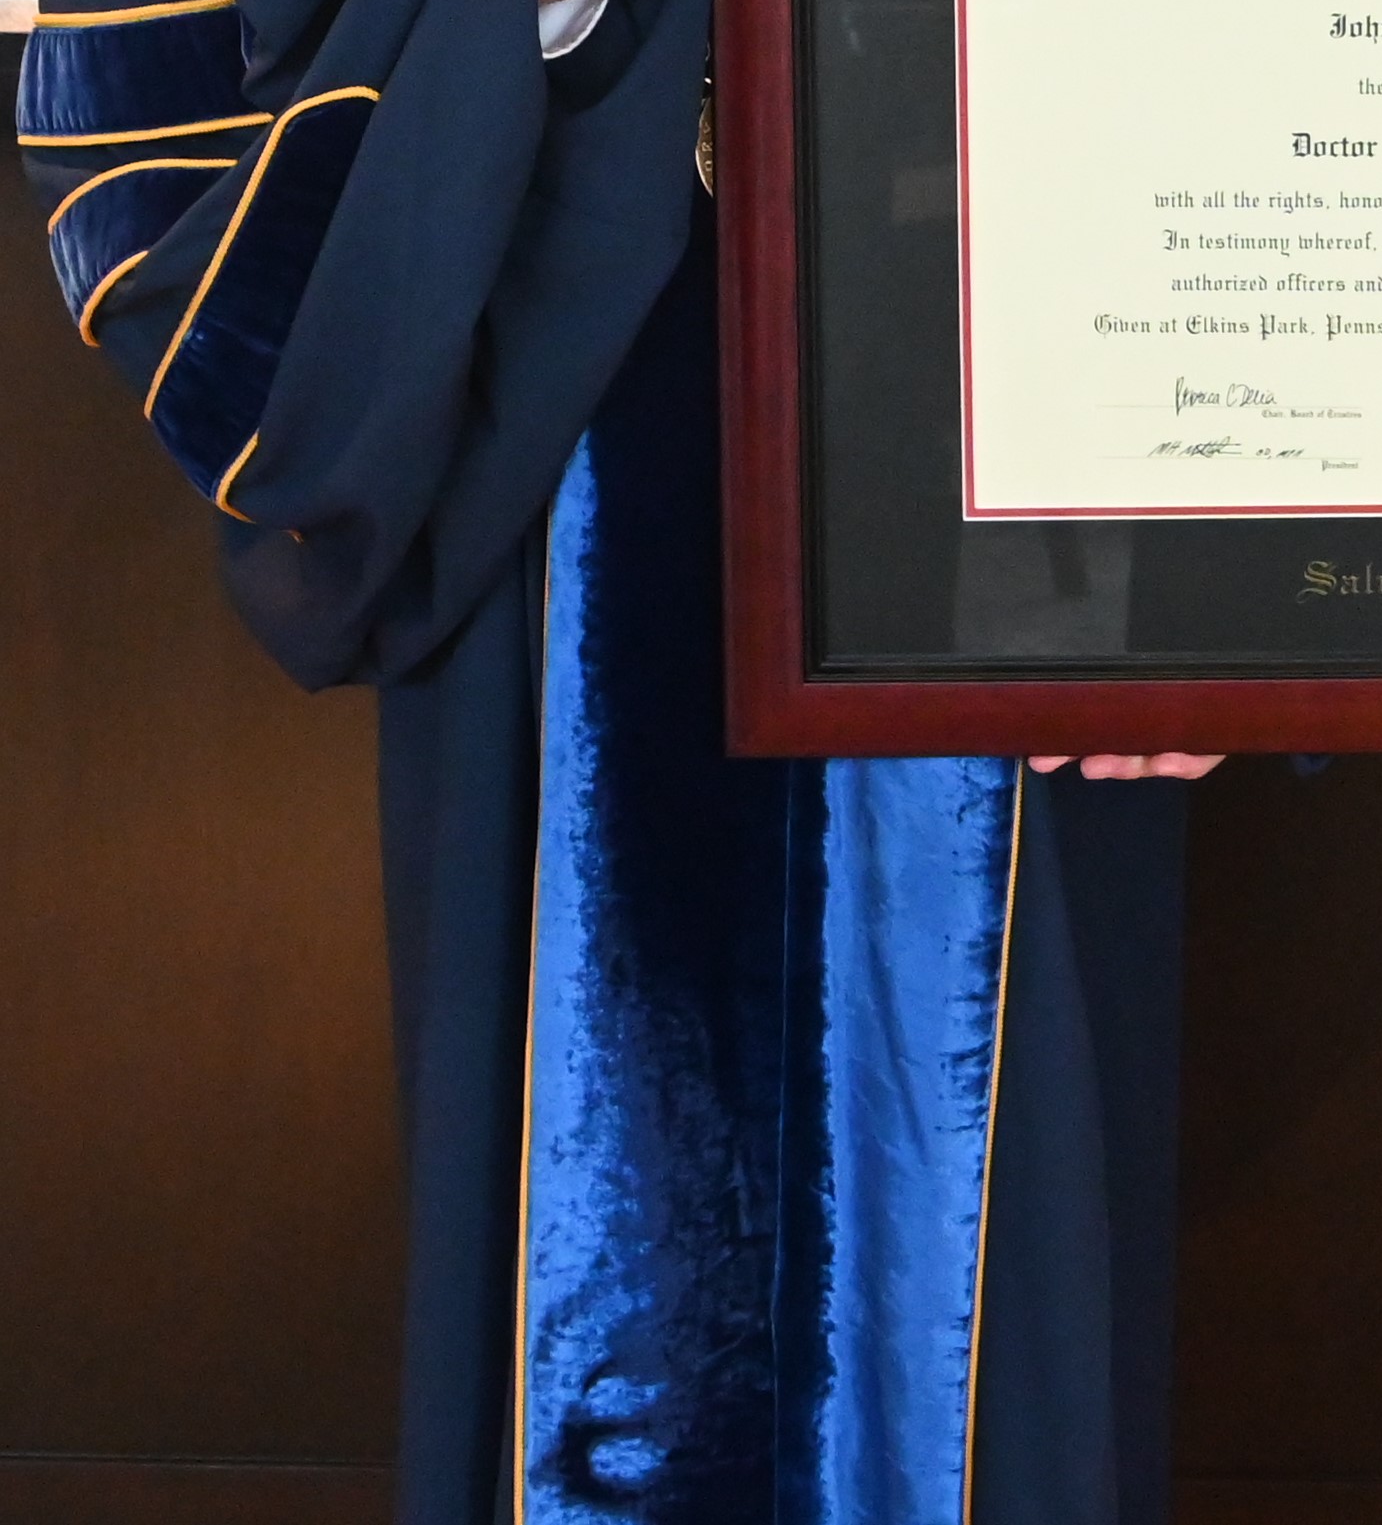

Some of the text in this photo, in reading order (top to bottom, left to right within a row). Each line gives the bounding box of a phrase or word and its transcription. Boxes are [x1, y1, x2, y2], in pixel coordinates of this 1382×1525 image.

[1291, 132, 1379, 158] Doctor
[1154, 190, 1195, 209] with
[1202, 190, 1225, 209] all
[1233, 190, 1260, 209] the
[1162, 228, 1190, 251] In
[1198, 232, 1291, 258] testimony
[1171, 272, 1268, 292] authorized
[1276, 272, 1346, 292] officers
[1093, 313, 1151, 336] Given
[1159, 317, 1178, 334] at
[1185, 314, 1250, 335] Elkins
